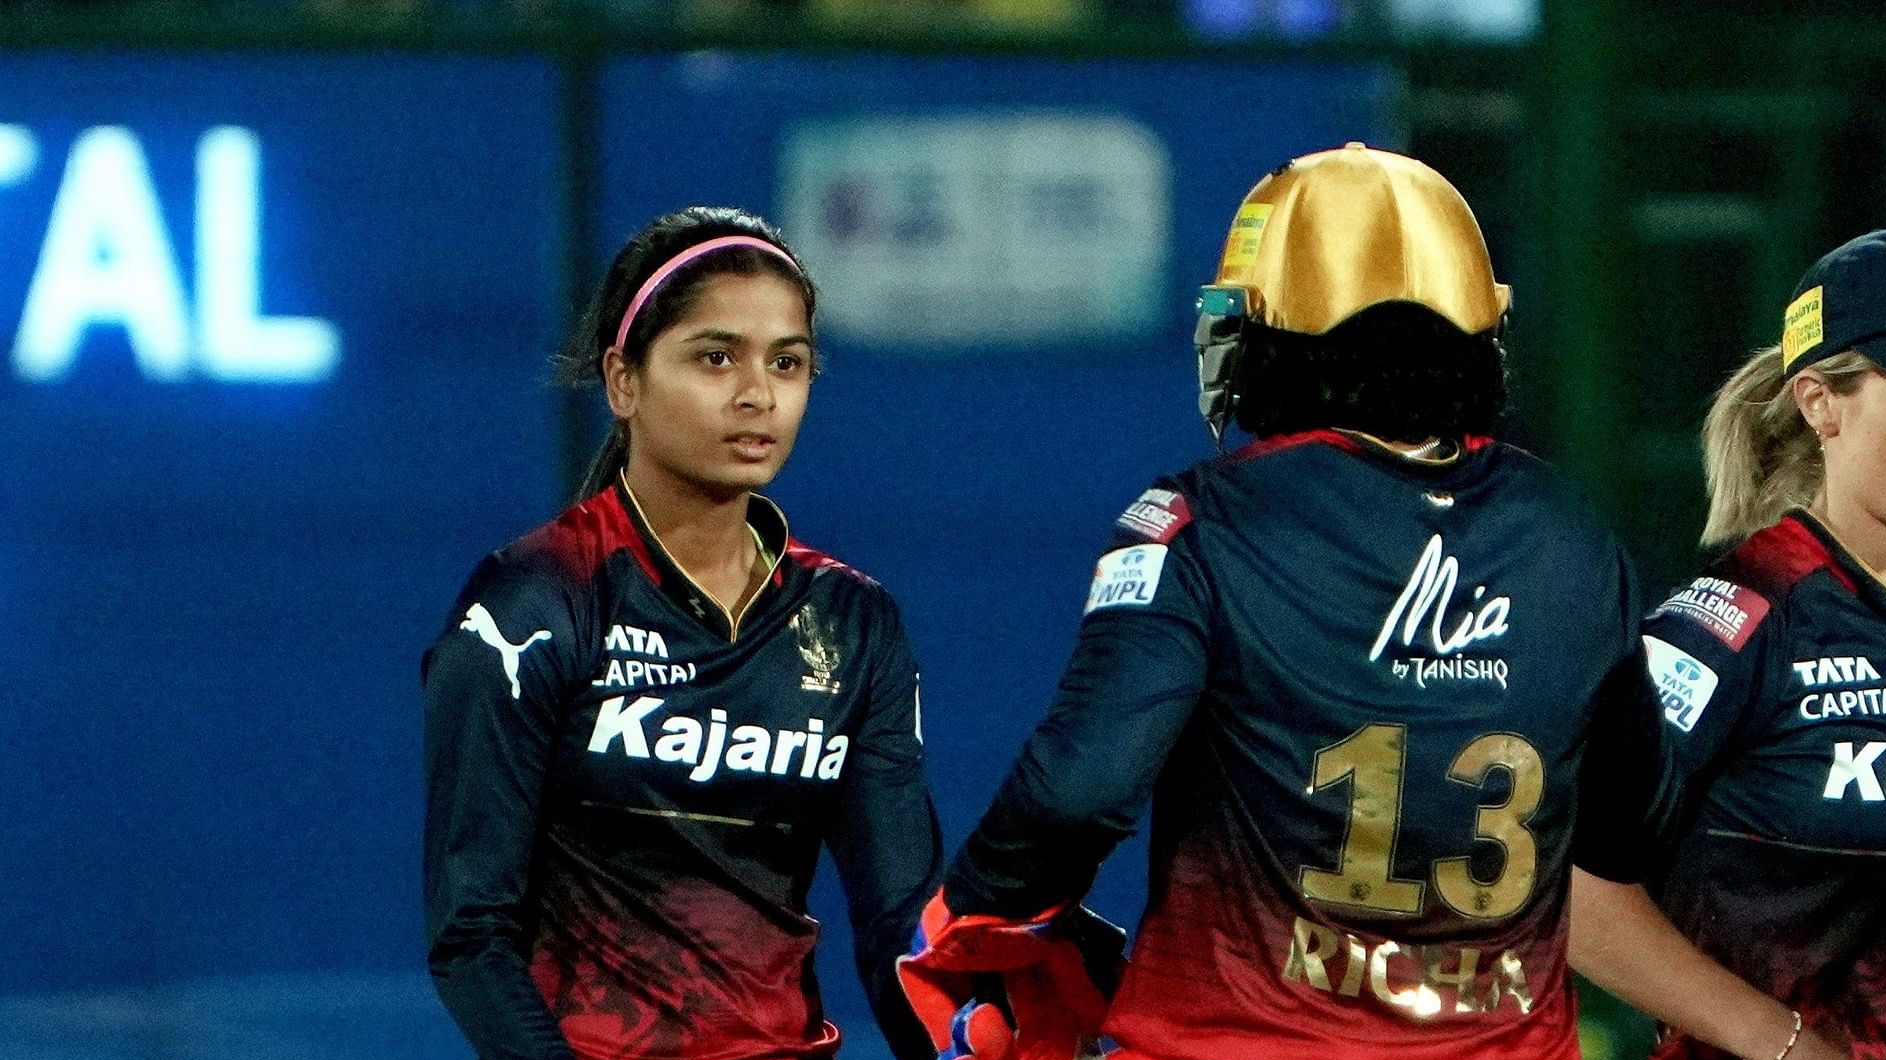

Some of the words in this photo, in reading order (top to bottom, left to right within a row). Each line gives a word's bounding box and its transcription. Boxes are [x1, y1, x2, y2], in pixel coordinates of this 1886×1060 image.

[1370, 533, 1511, 662] Mia
[605, 624, 669, 659] ATA
[1393, 659, 1410, 680] by
[1410, 653, 1508, 690] TANISHQ
[1662, 673, 1693, 700] TATA
[1793, 656, 1881, 687] TATA
[587, 695, 849, 782] Kajaria
[1298, 720, 1546, 920] 13
